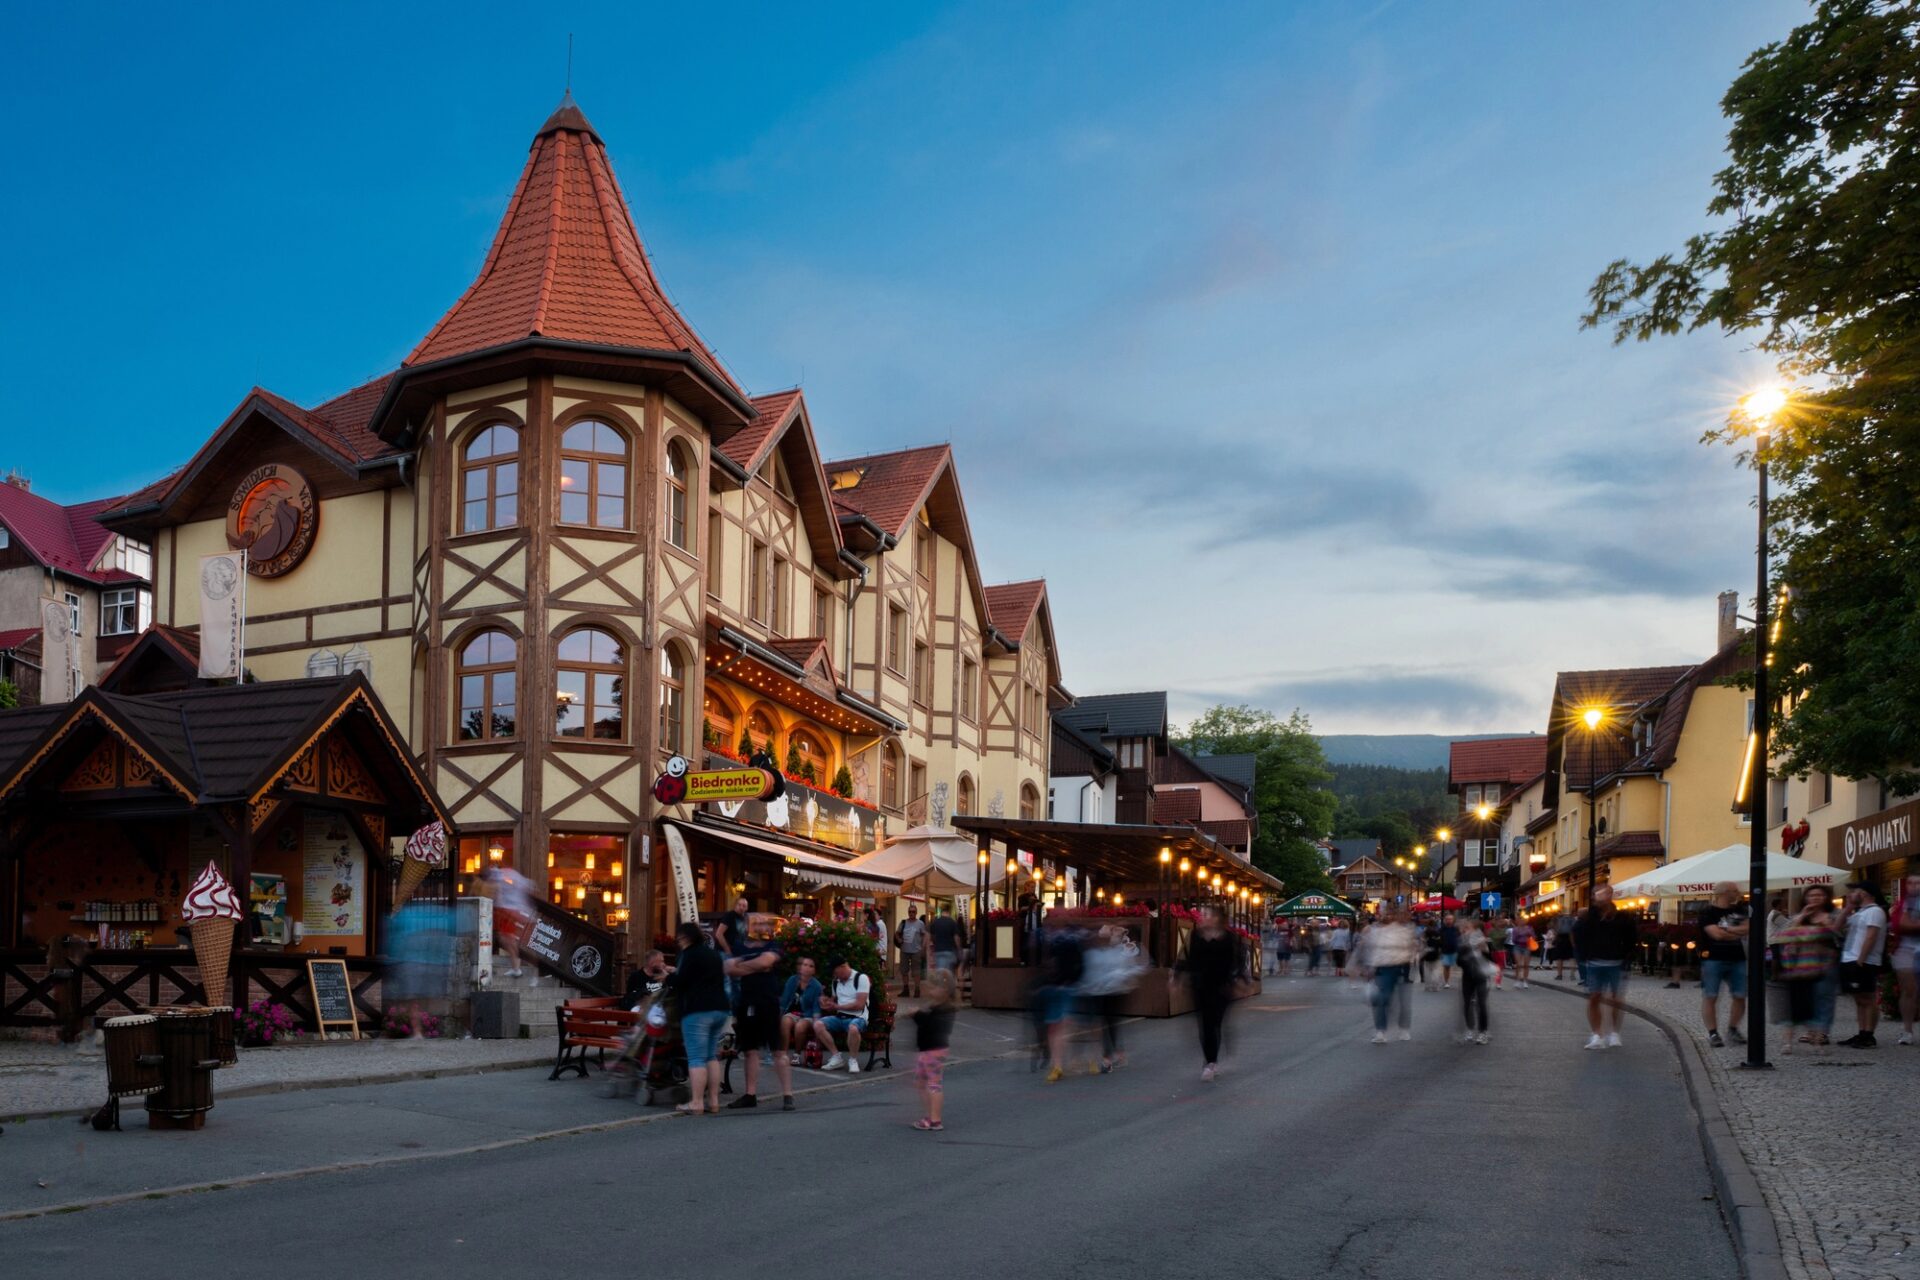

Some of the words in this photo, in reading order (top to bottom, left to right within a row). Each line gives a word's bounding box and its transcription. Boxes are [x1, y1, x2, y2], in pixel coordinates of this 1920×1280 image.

[691, 774, 760, 788] Biedronka
[1858, 814, 1911, 856] PAMIĄTKI
[1792, 873, 1833, 886] TYSKIE
[1676, 882, 1717, 893] TYSKIE
